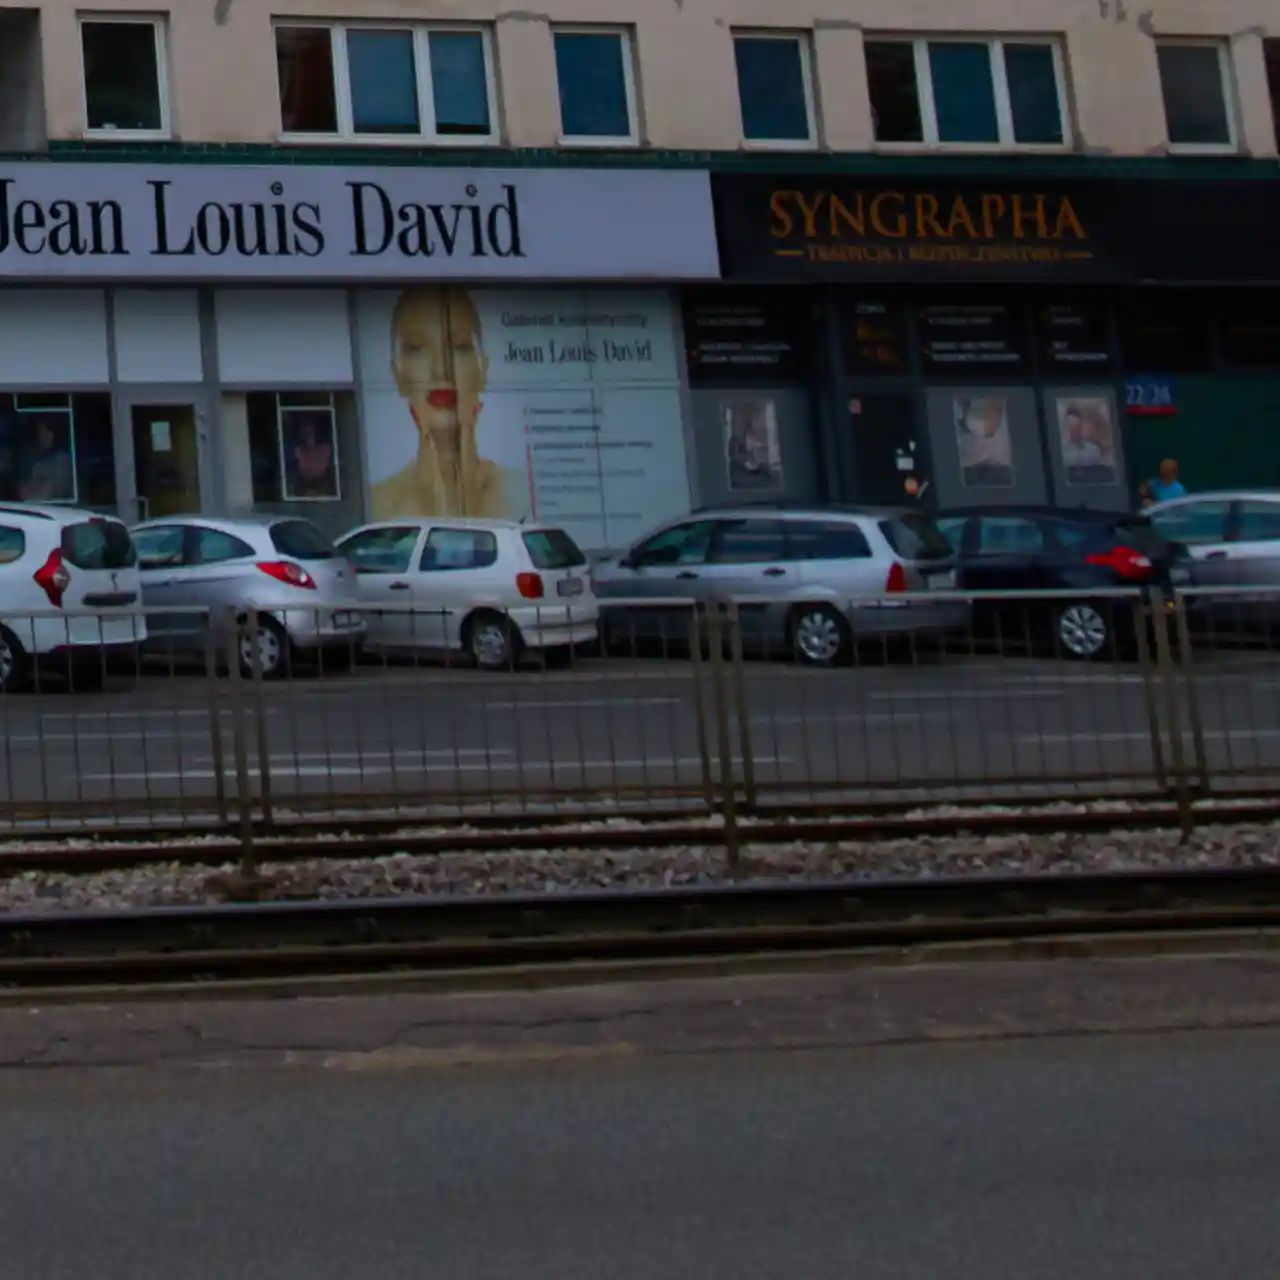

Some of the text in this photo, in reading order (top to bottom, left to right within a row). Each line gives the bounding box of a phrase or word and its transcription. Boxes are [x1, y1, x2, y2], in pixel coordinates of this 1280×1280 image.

[146, 180, 324, 257] Louis
[346, 181, 525, 258] David
[770, 190, 1087, 239] SYNGRAPHA
[504, 340, 544, 364] Jean
